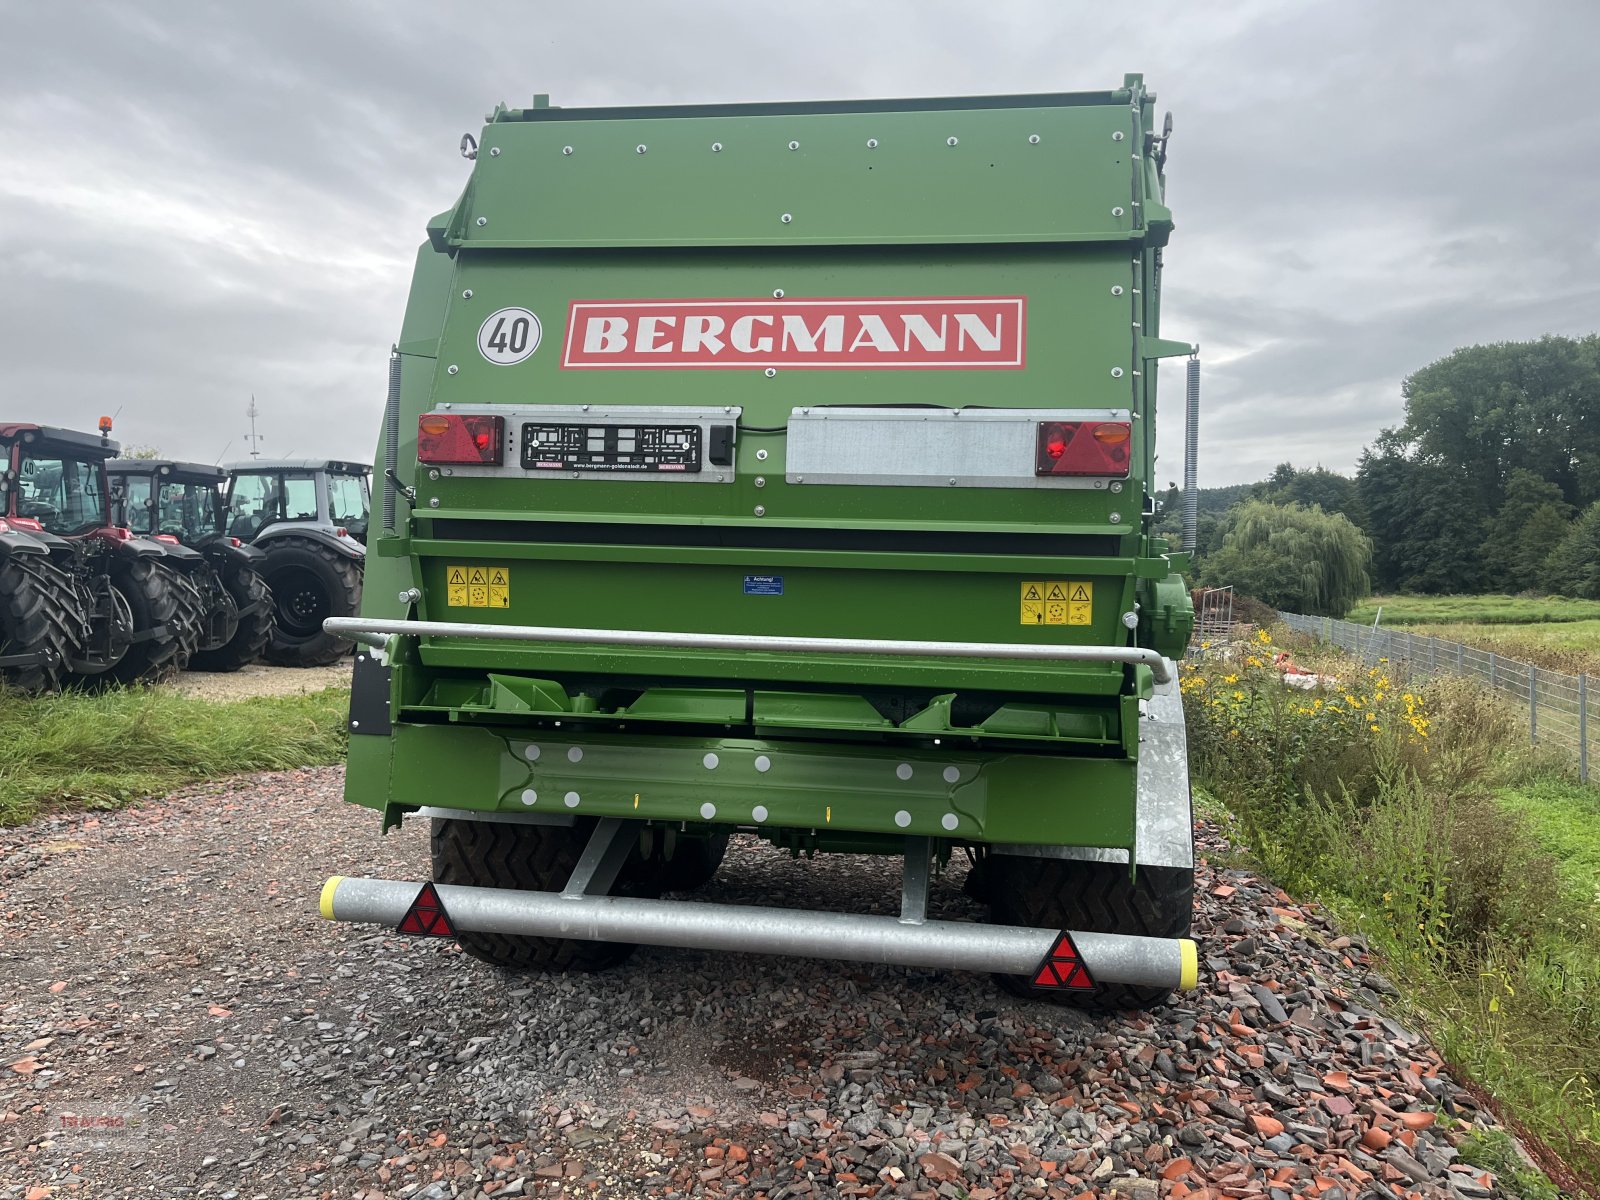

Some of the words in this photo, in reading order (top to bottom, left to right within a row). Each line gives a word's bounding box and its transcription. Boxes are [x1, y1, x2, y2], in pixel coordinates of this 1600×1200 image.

[487, 317, 530, 354] 40
[583, 314, 1002, 356] BERGMANN
[25, 461, 34, 475] 40
